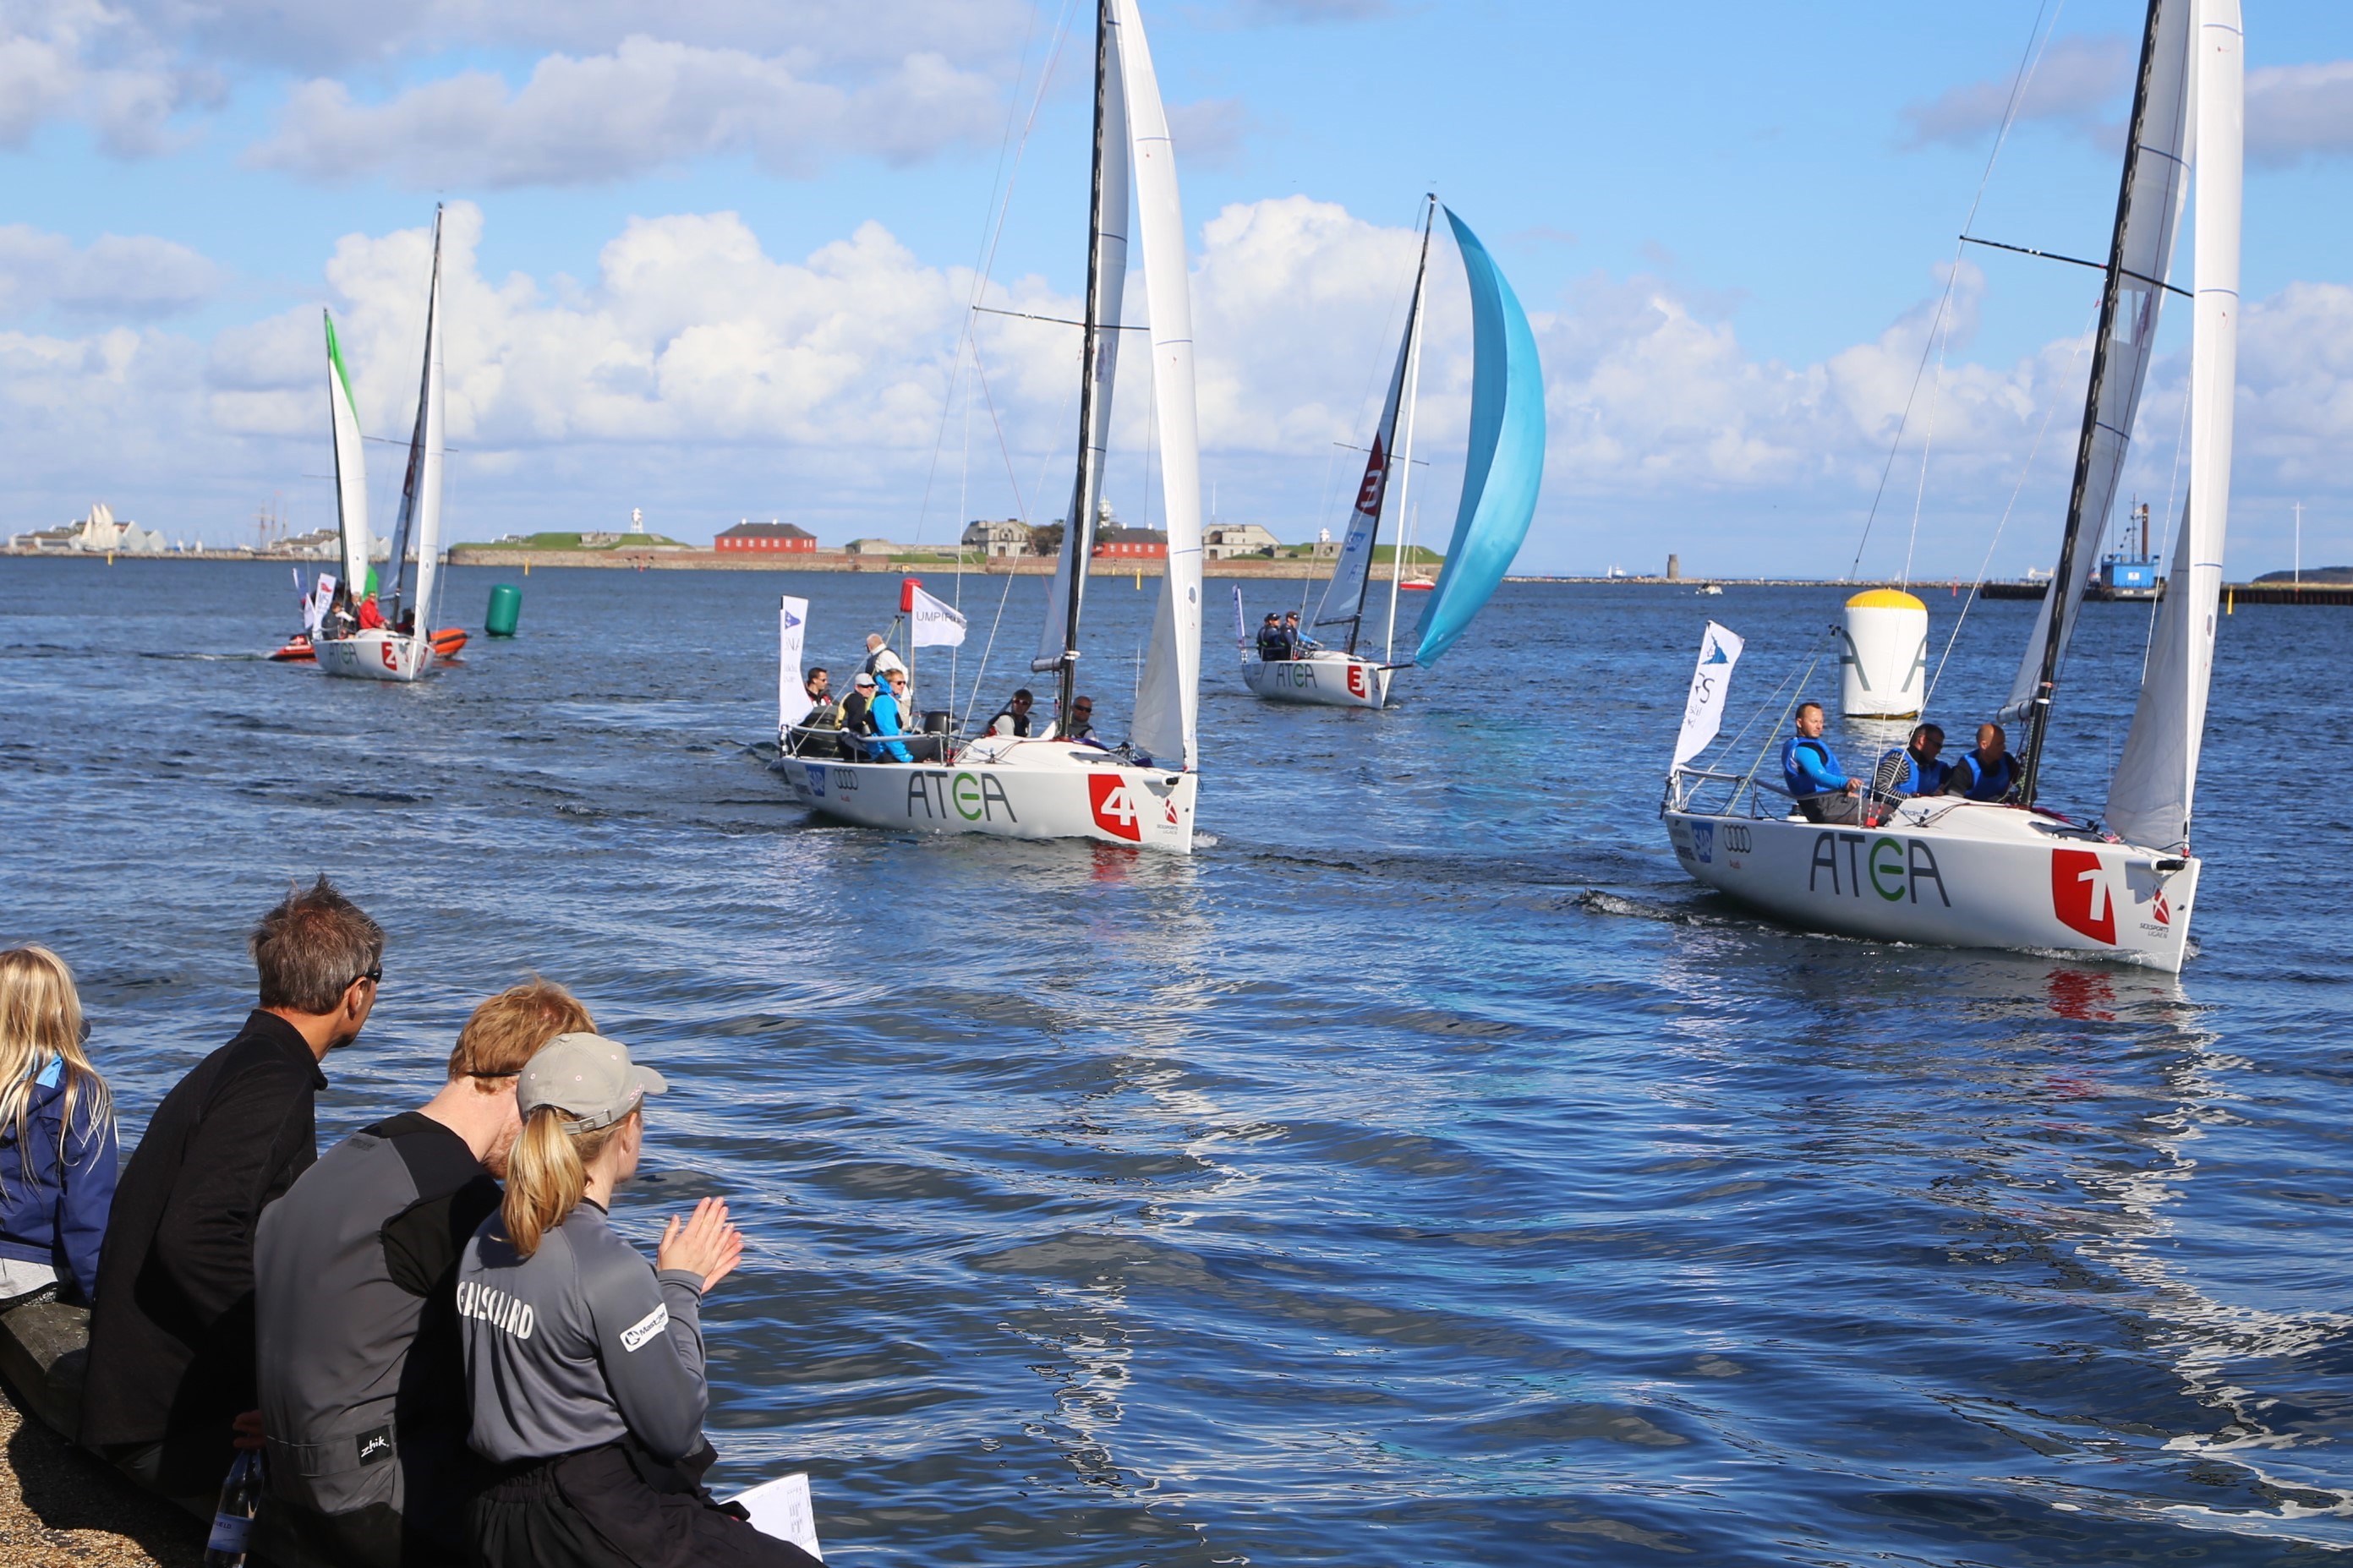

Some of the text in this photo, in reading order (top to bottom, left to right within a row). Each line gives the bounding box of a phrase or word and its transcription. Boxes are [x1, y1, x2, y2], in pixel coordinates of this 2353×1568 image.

[1360, 469, 1382, 507] 3
[329, 642, 360, 665] ATEA
[386, 645, 396, 664] 2
[1276, 663, 1318, 689] ATEA
[1351, 670, 1364, 691] 3
[907, 770, 1018, 823] ATEA
[1101, 785, 1135, 826] 4
[1692, 828, 1712, 857] SAP
[1809, 831, 1951, 908] ATEA
[2077, 868, 2108, 921] 1
[361, 1436, 387, 1458] zhik
